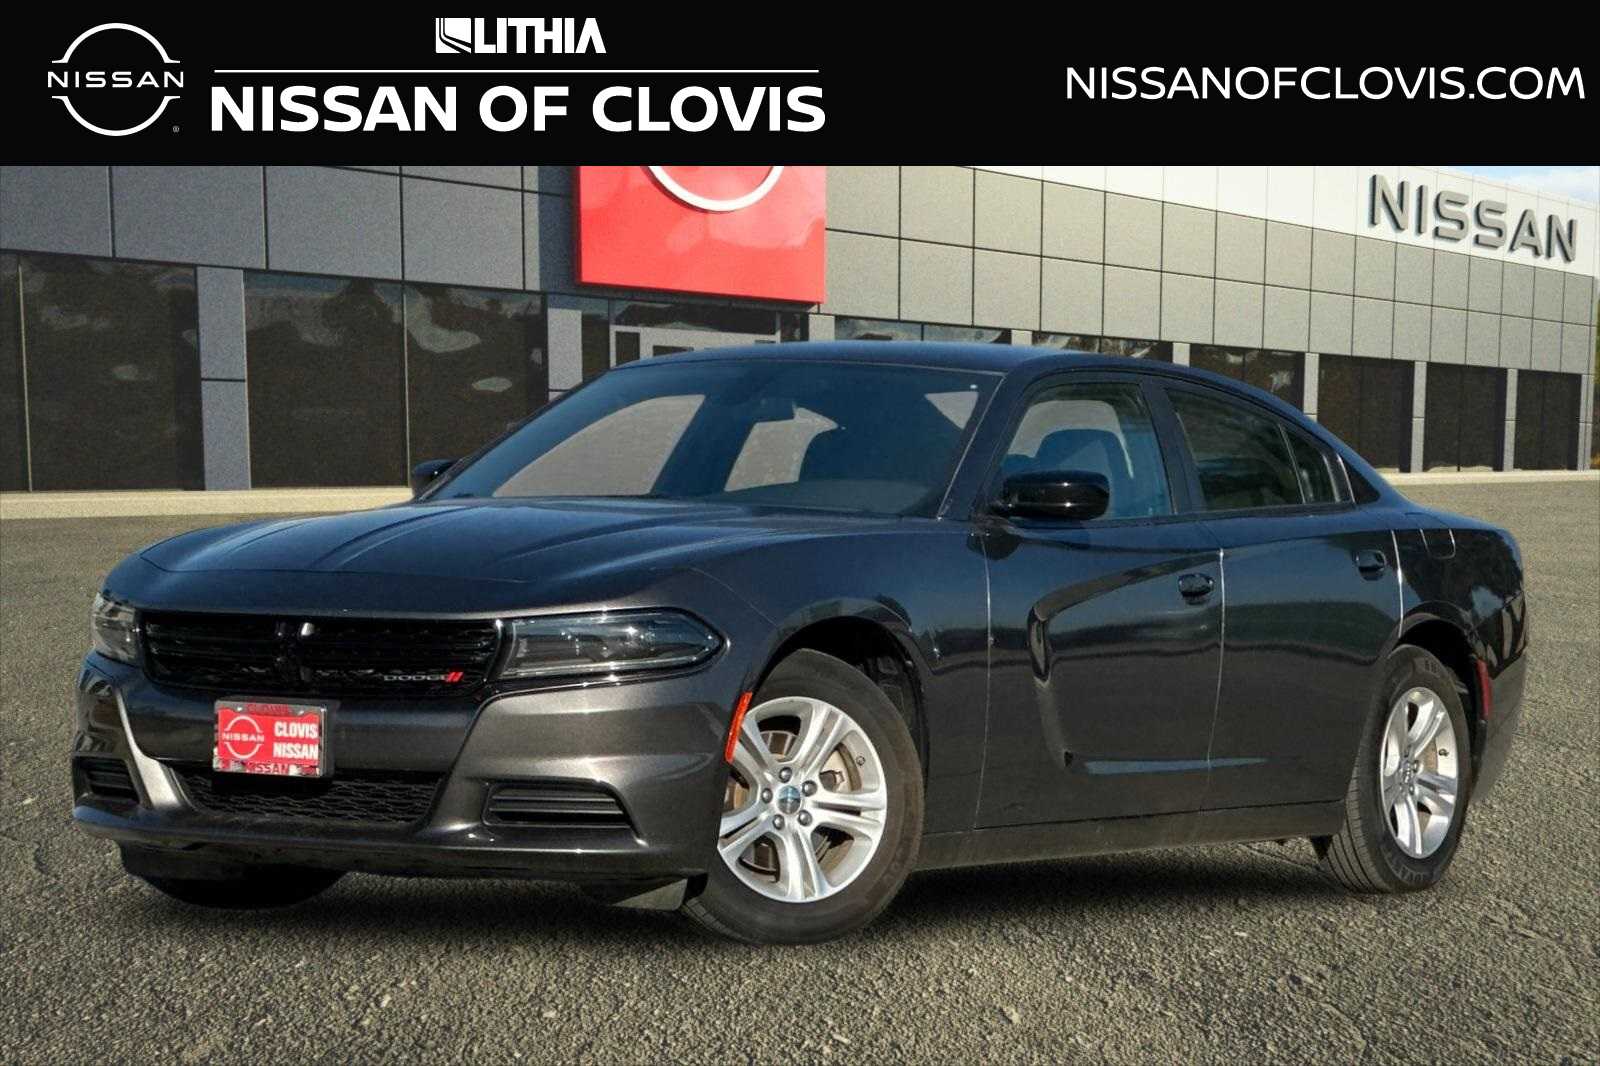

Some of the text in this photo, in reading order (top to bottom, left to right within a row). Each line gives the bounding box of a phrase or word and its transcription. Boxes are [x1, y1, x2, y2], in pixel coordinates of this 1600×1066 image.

[1369, 174, 1578, 263] NISSAN
[222, 732, 264, 742] NISSAN
[274, 721, 319, 739] CLOVIS
[272, 742, 319, 759] NISSAN
